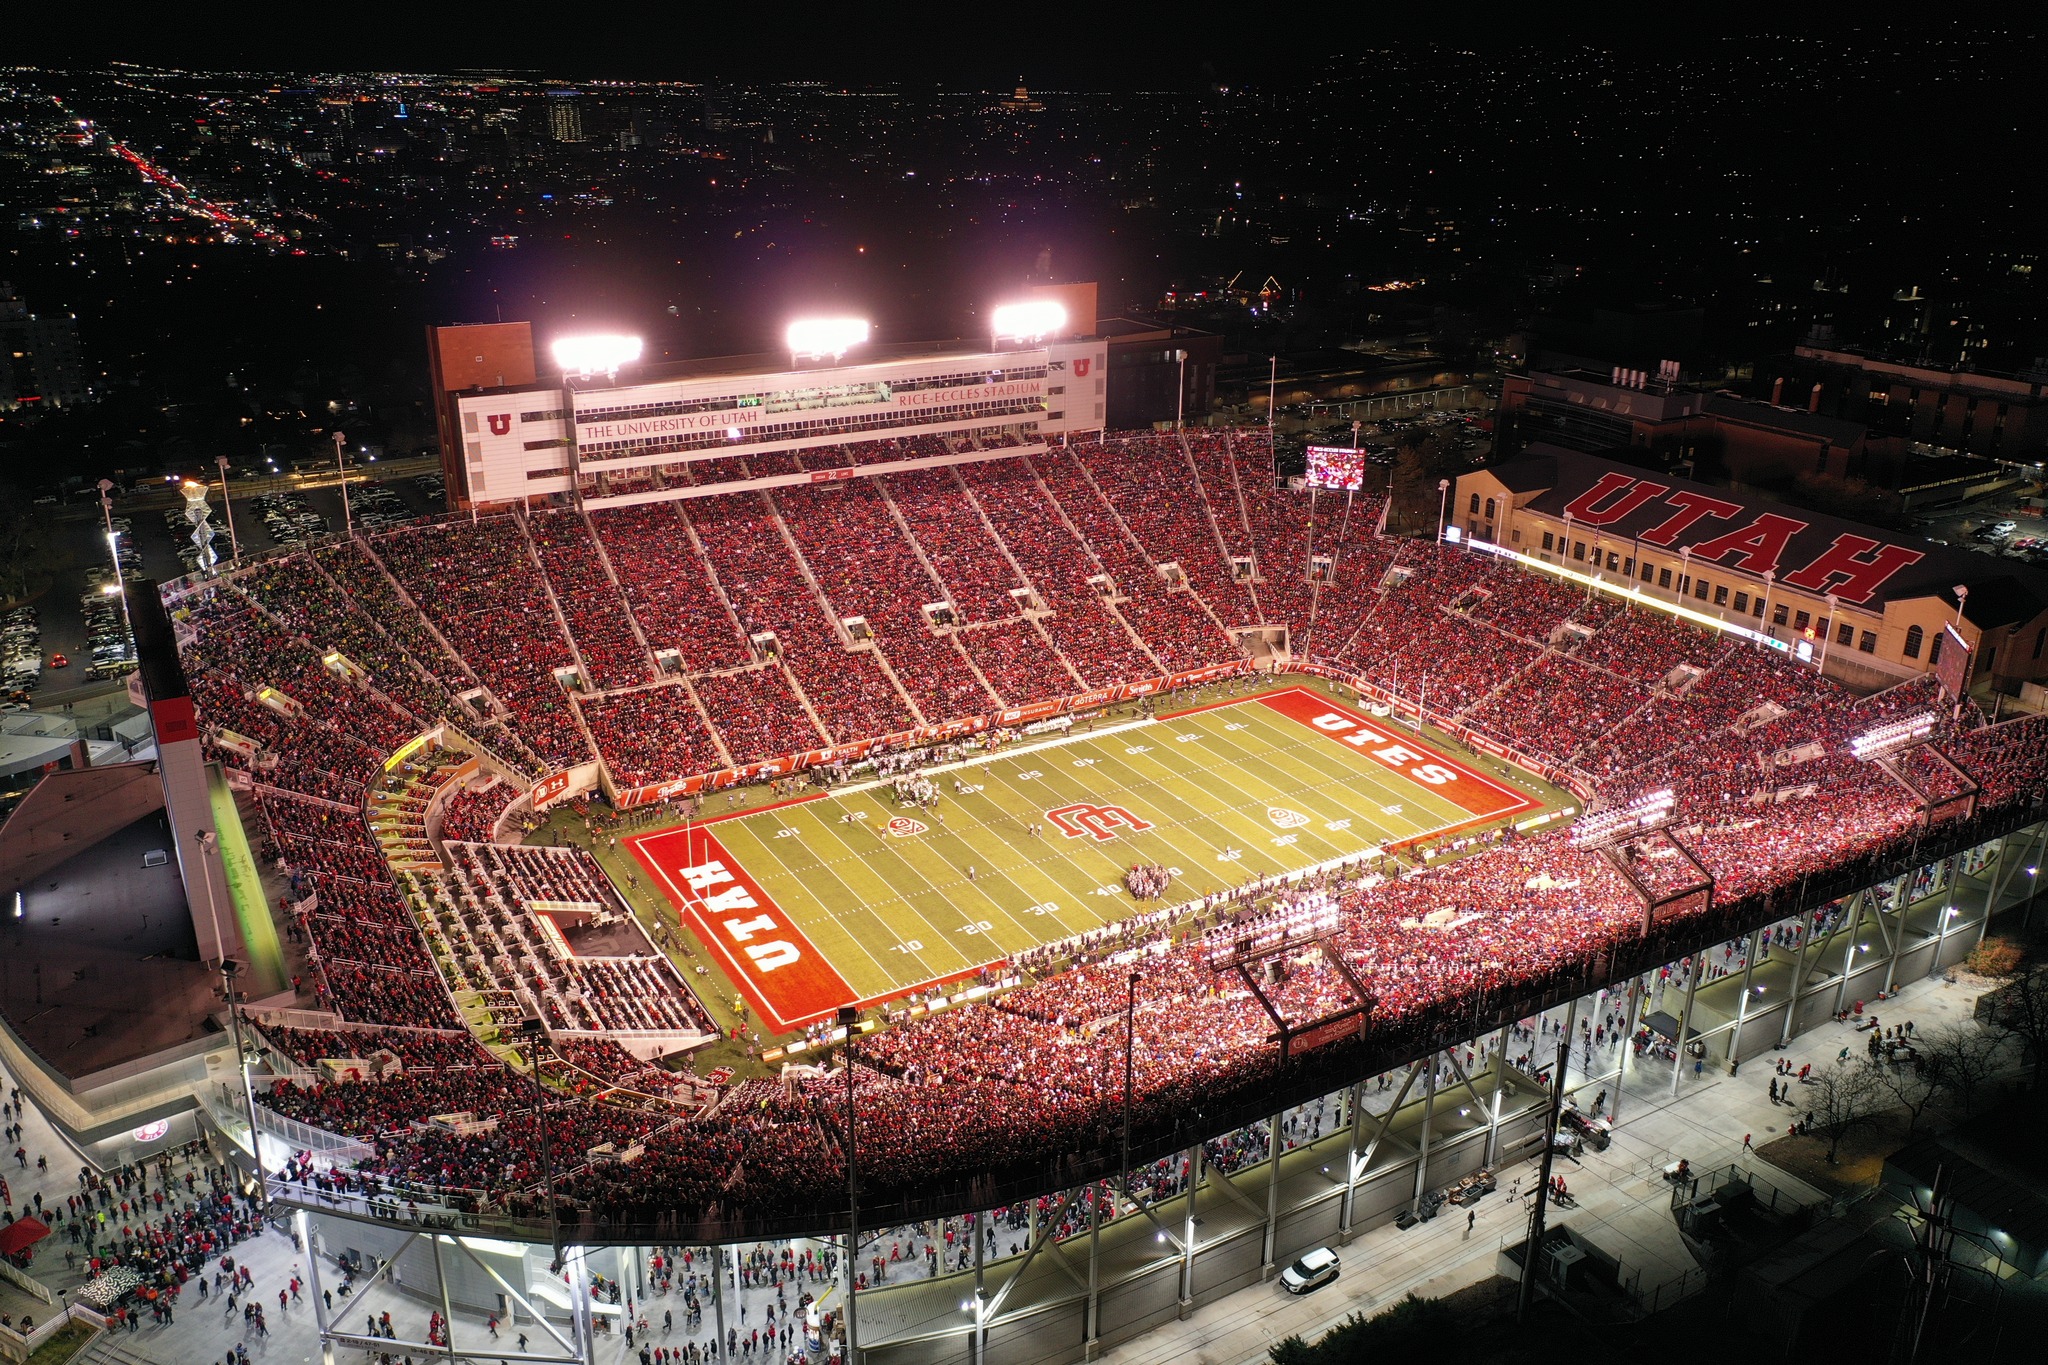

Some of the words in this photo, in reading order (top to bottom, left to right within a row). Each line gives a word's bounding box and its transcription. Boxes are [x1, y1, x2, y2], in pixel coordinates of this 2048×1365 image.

[899, 388, 980, 406] RICE-ECCLES
[983, 382, 1041, 398] STADIUM
[487, 413, 511, 436] U
[585, 427, 613, 439] THE
[617, 417, 697, 437] UNIVERSITY
[700, 414, 718, 427] OF
[722, 411, 757, 425] UTAH
[828, 471, 837, 480] 22
[1563, 472, 1926, 604] UTAH
[1020, 704, 1055, 716] INSURANCE
[1224, 722, 1245, 731] 10
[1175, 733, 1200, 743] 20
[1124, 745, 1151, 755] 30
[1312, 712, 1458, 785] UTES
[1072, 758, 1095, 767] 40
[1018, 770, 1044, 780] 50
[961, 784, 985, 794] 40
[1380, 805, 1402, 816] 10
[1324, 820, 1351, 831] 20
[777, 827, 801, 838] 10
[1270, 835, 1298, 847] 30
[1097, 884, 1123, 897] 40
[1030, 902, 1060, 916] 30
[679, 860, 801, 973] UTAH
[962, 920, 994, 936] 20
[897, 939, 924, 954] 10
